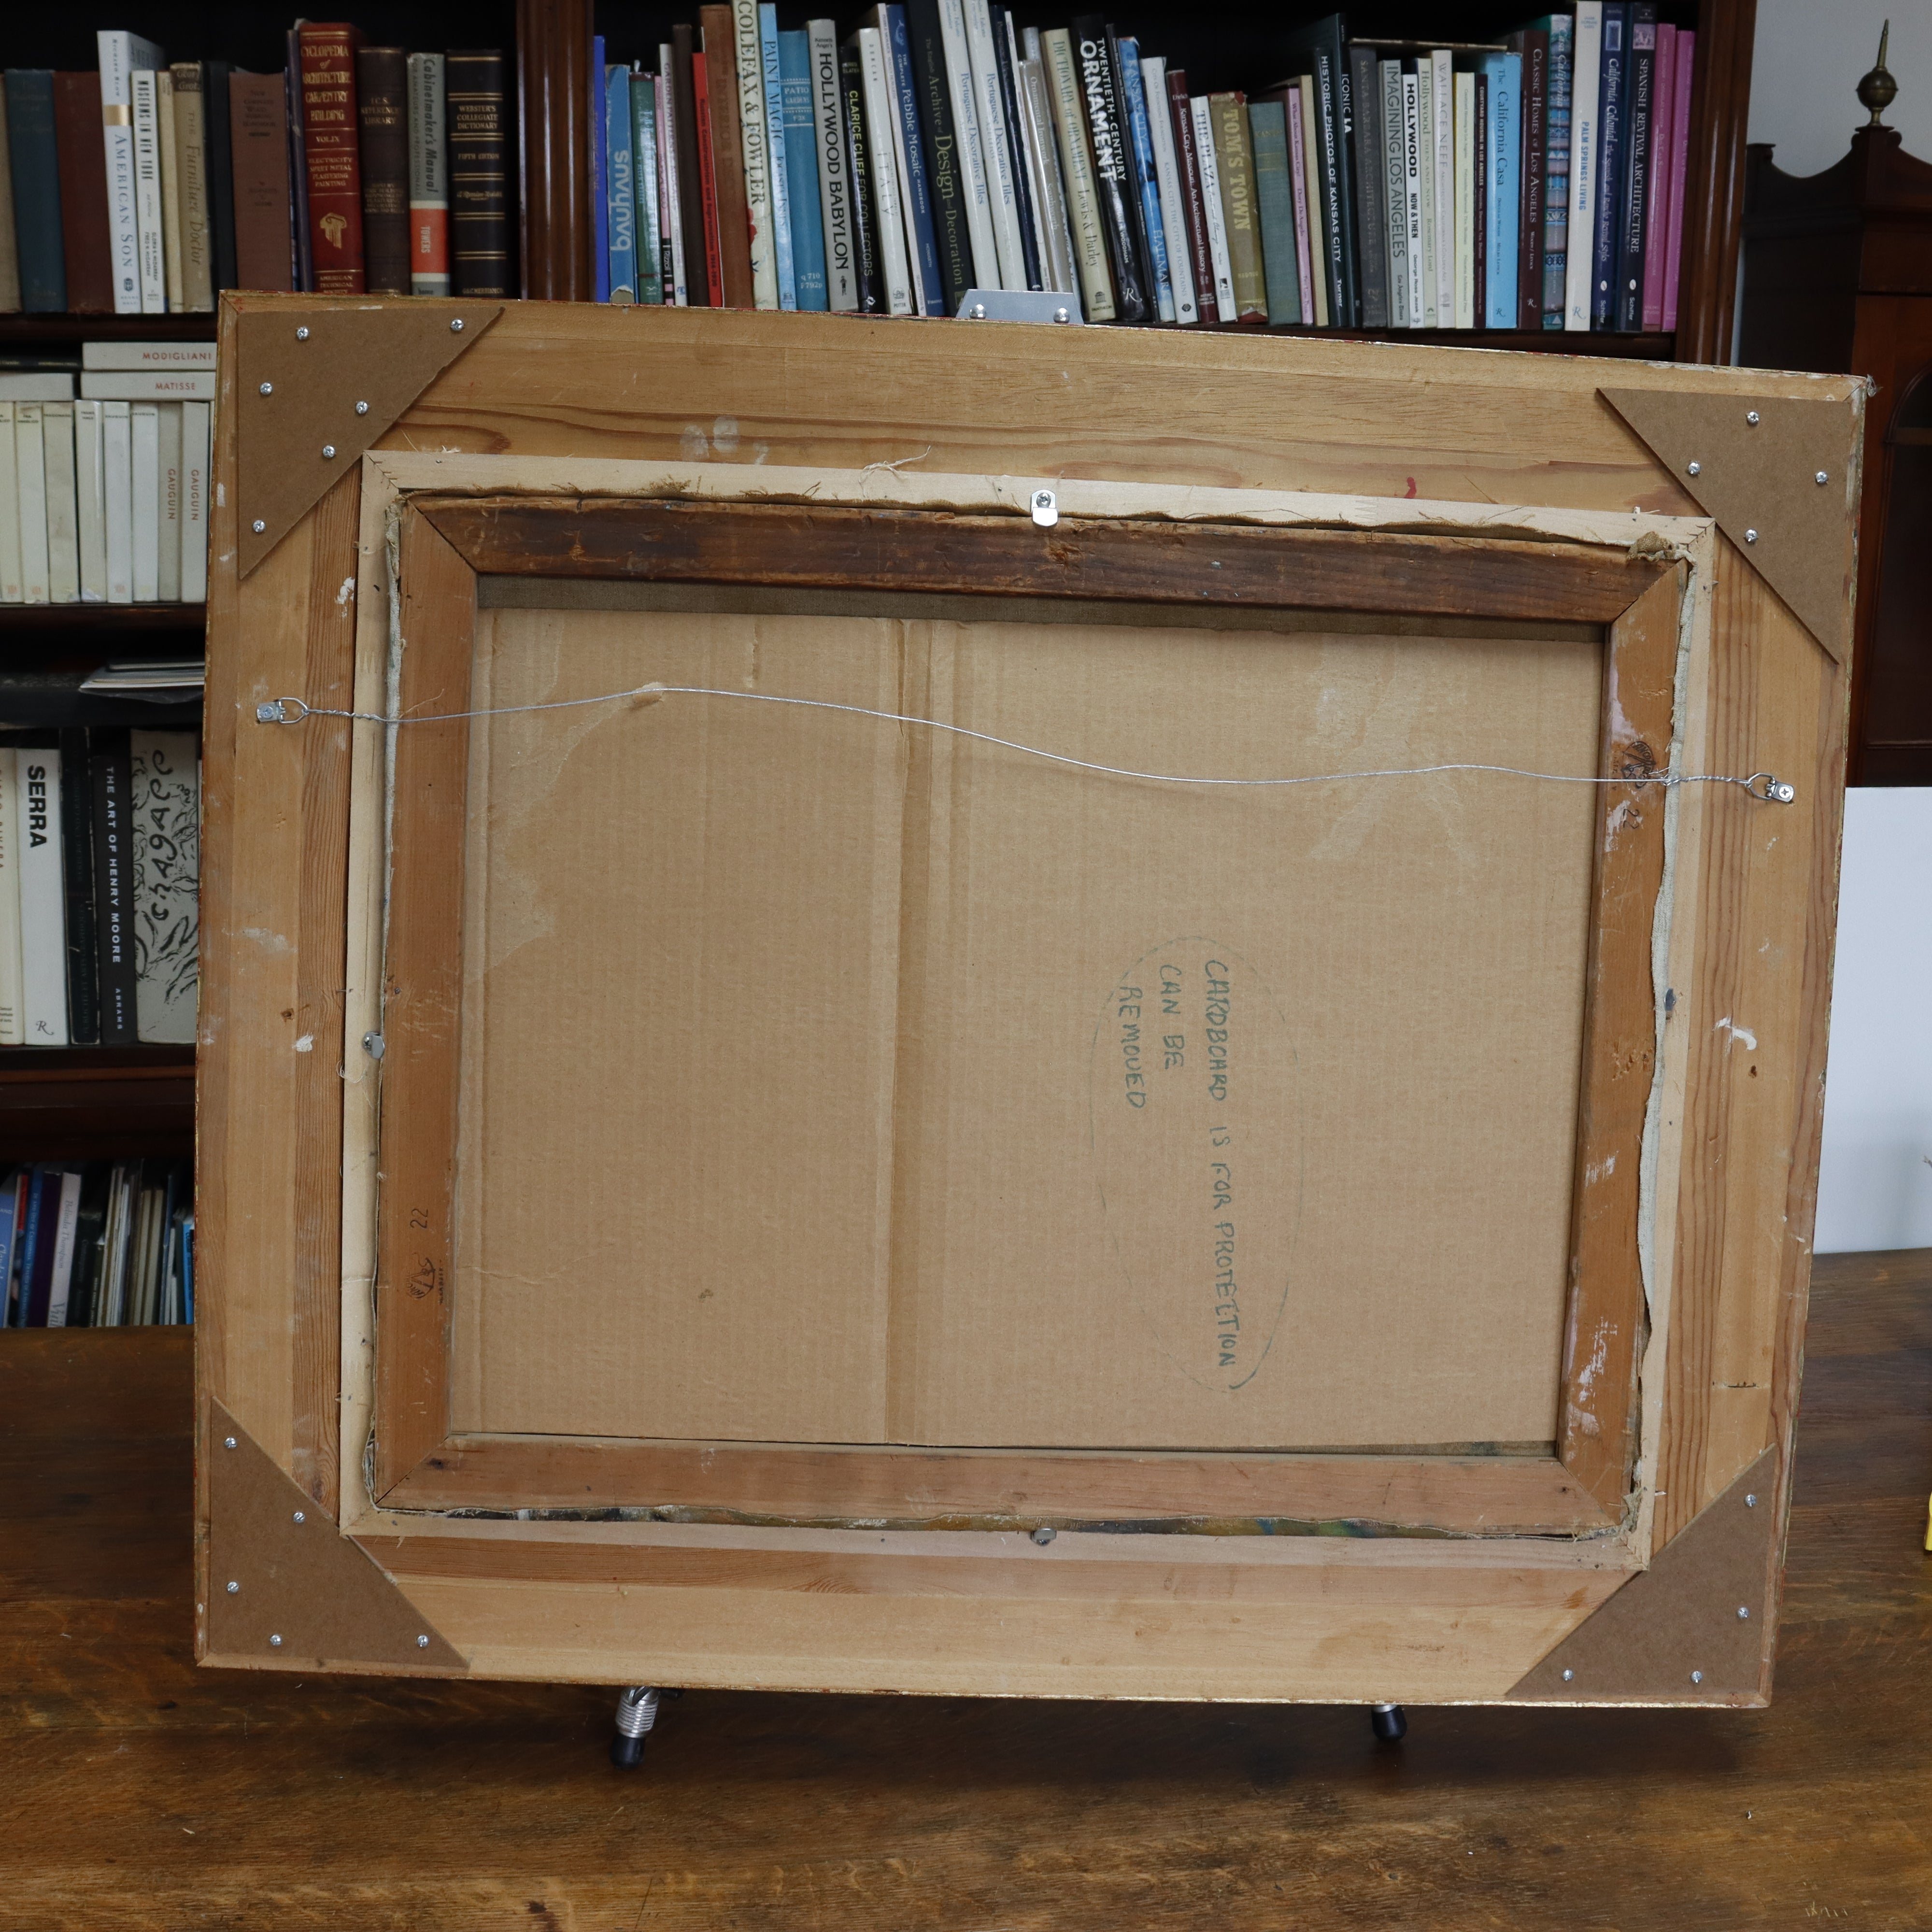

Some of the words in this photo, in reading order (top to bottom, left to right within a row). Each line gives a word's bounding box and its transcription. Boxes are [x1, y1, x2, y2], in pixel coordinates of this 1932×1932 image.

[301, 45, 349, 57] CYCLOPEDIA
[738, 1, 758, 95] COLEFAX
[765, 41, 780, 85] PAINT
[869, 44, 878, 81] DUNCAN
[1533, 48, 1543, 93] CLASSIC
[1052, 42, 1075, 104] DICTIONARY
[1321, 56, 1332, 113] HISTORIC
[1342, 74, 1350, 113] ICONIC
[1360, 60, 1369, 98] SANTA
[1438, 63, 1448, 127] WALLACE
[1498, 69, 1506, 85] The
[1555, 55, 1569, 108] California
[1603, 58, 1621, 103] California
[1637, 58, 1649, 107] SPANISH
[306, 91, 347, 103] CARPENTRY
[311, 110, 345, 121] BUILDING
[423, 58, 436, 144] Cabinetmaker's
[746, 102, 759, 116] &
[767, 92, 783, 144] MAGIC
[819, 53, 841, 174] HOLLYWOOD
[849, 91, 862, 140] CLARICE
[929, 76, 942, 125] Archive
[960, 73, 974, 124] Portuguese
[1030, 77, 1045, 125] Ornamental
[1064, 108, 1076, 119] of
[1079, 40, 1118, 180] ORNAMENT
[1387, 66, 1402, 153] IMAGINING
[1421, 71, 1431, 134] Hollywood
[1532, 97, 1542, 134] HOMES
[139, 124, 151, 133] IN
[986, 73, 1002, 124] Portuguese
[994, 128, 1008, 181] Decorative
[1002, 184, 1013, 204] Tiles
[1180, 108, 1189, 133] Kansas
[1195, 111, 1209, 142] THE
[1222, 109, 1244, 168] TOM'S
[1325, 116, 1335, 164] PHOTOS
[1344, 118, 1352, 134] LA
[1362, 101, 1372, 154] BARBARA
[1407, 83, 1417, 178] HOLLYWOOD
[1497, 91, 1509, 153] California
[1581, 121, 1590, 142] PALM
[1605, 105, 1619, 142] Colonial
[1635, 113, 1646, 159] REVIVAL
[746, 122, 766, 204] FOWLER
[853, 143, 865, 175] CLIFF
[902, 89, 915, 130] Pebble
[909, 134, 923, 176] Mosaic
[917, 179, 925, 213] HANDBOOK
[935, 135, 955, 199] Design
[966, 128, 980, 180] Decorative
[1037, 128, 1050, 165] Ironwork
[1065, 123, 1088, 181] ORNAMENT
[1200, 145, 1215, 189] PLAZA
[1439, 134, 1448, 169] NEFF
[1531, 153, 1541, 172] LOS
[1580, 146, 1590, 181] SPRINGS
[115, 135, 129, 224] AMERICAN
[185, 145, 202, 213] Furniture
[426, 148, 439, 192] Manual
[856, 179, 867, 199] FOR
[878, 152, 895, 217] ITALY
[1328, 169, 1336, 184] OF
[1390, 158, 1403, 186] LOS
[1496, 158, 1508, 185] Casa
[610, 150, 631, 250] bauhaus
[974, 184, 986, 204] Tiles
[1078, 189, 1093, 218] Lewis
[1229, 175, 1250, 230] TOWN
[1330, 187, 1339, 235] KANSAS
[1364, 158, 1376, 245] ARCHITECTURE
[1410, 193, 1419, 210] NOW
[1529, 177, 1540, 223] ANGELES
[1578, 184, 1588, 211] LIVING
[1630, 163, 1644, 253] ARCHITECTURE
[189, 221, 204, 265] Doctor
[421, 226, 431, 253] TOWERS
[829, 181, 848, 270] BABYLON
[859, 204, 873, 276] COLLECTORS
[1082, 221, 1094, 229] &
[1164, 162, 1174, 187] KANSAS
[1176, 256, 1187, 296] FOUNTAINS
[1193, 201, 1205, 245] Architectural
[1391, 189, 1405, 258] ANGELES
[121, 234, 134, 267] SON
[946, 210, 964, 284] Decoration
[1084, 235, 1101, 267] Darley
[1151, 230, 1169, 297] HALLMARK
[1196, 247, 1207, 271] History
[155, 382, 196, 390] MATISSE
[105, 767, 115, 793] THE
[28, 765, 47, 848] SERRA
[107, 800, 117, 829] ART
[109, 834, 117, 853] OF
[108, 858, 120, 906] HENRY
[112, 912, 121, 963] MOORE
[115, 988, 124, 1030] ABRAMS
[1160, 964, 1183, 1014] CAN
[1162, 1035, 1185, 1070] BE
[1206, 960, 1230, 1101] CARDBOARD
[1209, 1126, 1231, 1147] IS
[1210, 1163, 1231, 1209] FOR
